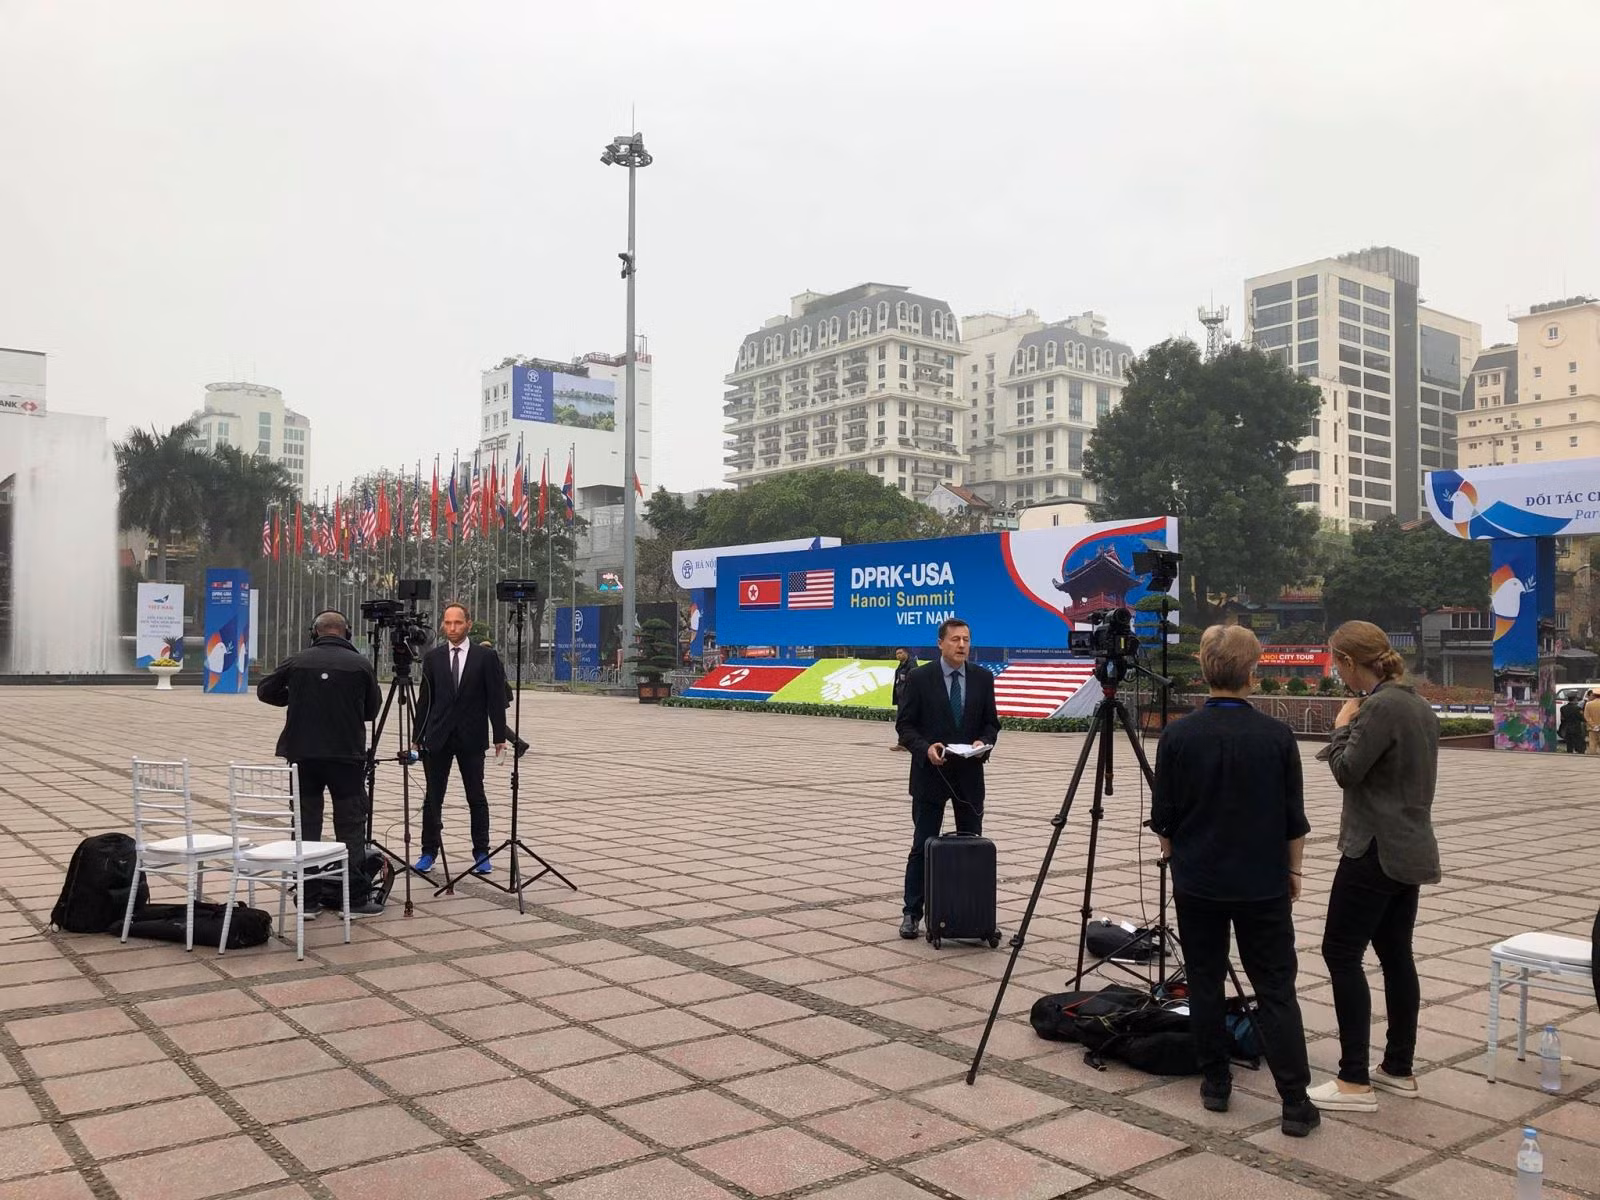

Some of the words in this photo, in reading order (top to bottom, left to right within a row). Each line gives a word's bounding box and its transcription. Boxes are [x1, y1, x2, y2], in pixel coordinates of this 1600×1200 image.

[1525, 493, 1551, 507] ĐỐI
[1555, 491, 1583, 505] TÁC
[695, 560, 704, 569] HÀ
[851, 561, 955, 590] DPRK-USA
[850, 592, 891, 608] Hanoi
[896, 590, 955, 607] Summit
[896, 611, 922, 625] VIET
